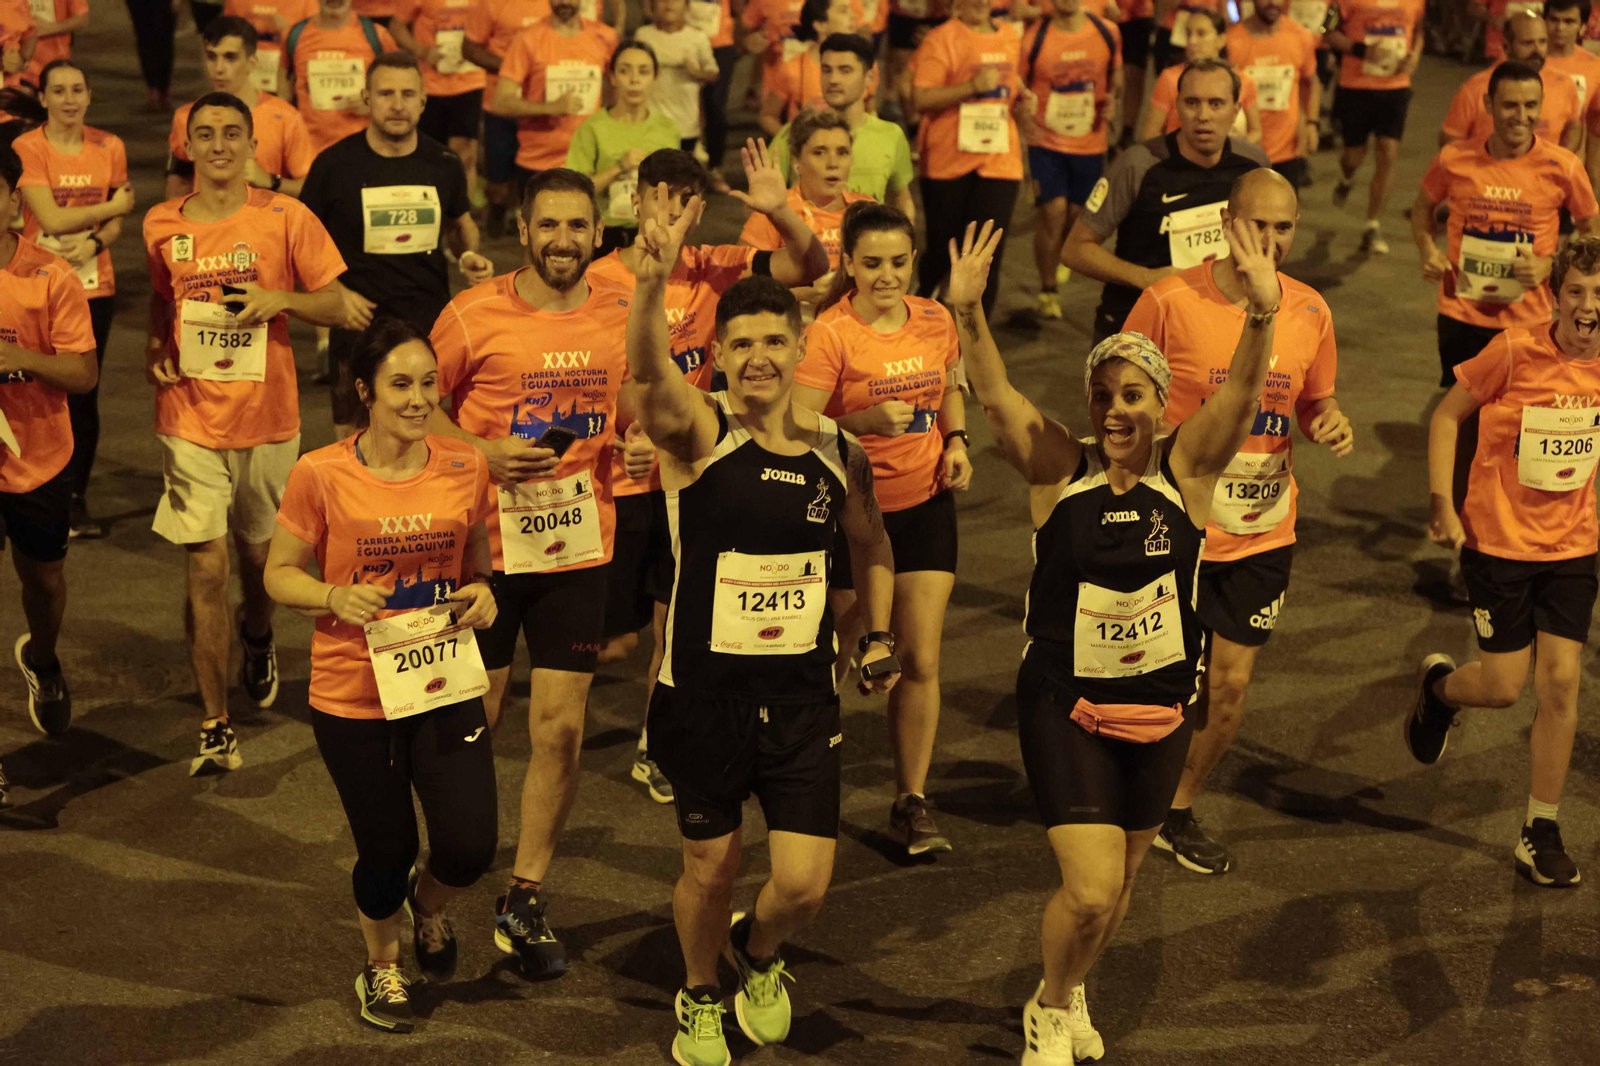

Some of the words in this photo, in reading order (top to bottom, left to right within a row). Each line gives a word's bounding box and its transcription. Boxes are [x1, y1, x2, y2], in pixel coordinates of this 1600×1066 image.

[60, 174, 92, 186] XXXV
[1484, 186, 1522, 200] XXXV
[389, 210, 417, 225] 728
[196, 256, 229, 272] XXX
[1476, 261, 1512, 277] 1087
[181, 272, 214, 282] CARRERA
[187, 275, 258, 290] GUADALQUIVIR
[197, 330, 252, 348] 17582
[542, 350, 591, 369] XXXV
[883, 356, 923, 377] XXXV
[521, 371, 561, 380] CARRERA
[565, 369, 608, 378] NOCTURNA
[868, 377, 903, 387] CARRERA
[906, 370, 940, 381] NOCTURNA
[528, 377, 608, 389] GUADALQUIVIR
[875, 377, 941, 396] GUADALQUIVIR
[525, 396, 547, 406] KH7
[1551, 394, 1597, 409] XXXV
[1539, 437, 1593, 456] 13206
[761, 467, 807, 485] Joma
[1225, 480, 1280, 500] 13209
[520, 507, 582, 534] 20048
[808, 505, 829, 521] CAR
[1101, 509, 1140, 525] Joma
[378, 513, 432, 534] XXXV
[357, 537, 401, 545] CARRERA
[405, 531, 455, 542] NOCTURNA
[1146, 539, 1170, 553] CAR
[364, 540, 455, 556] GUADALQUIVIR
[363, 564, 388, 573] KH7
[738, 590, 805, 612] 12413
[760, 629, 780, 637] KH7
[1096, 611, 1163, 641] 12412
[393, 638, 458, 673] 20077
[426, 681, 443, 692] KH7
